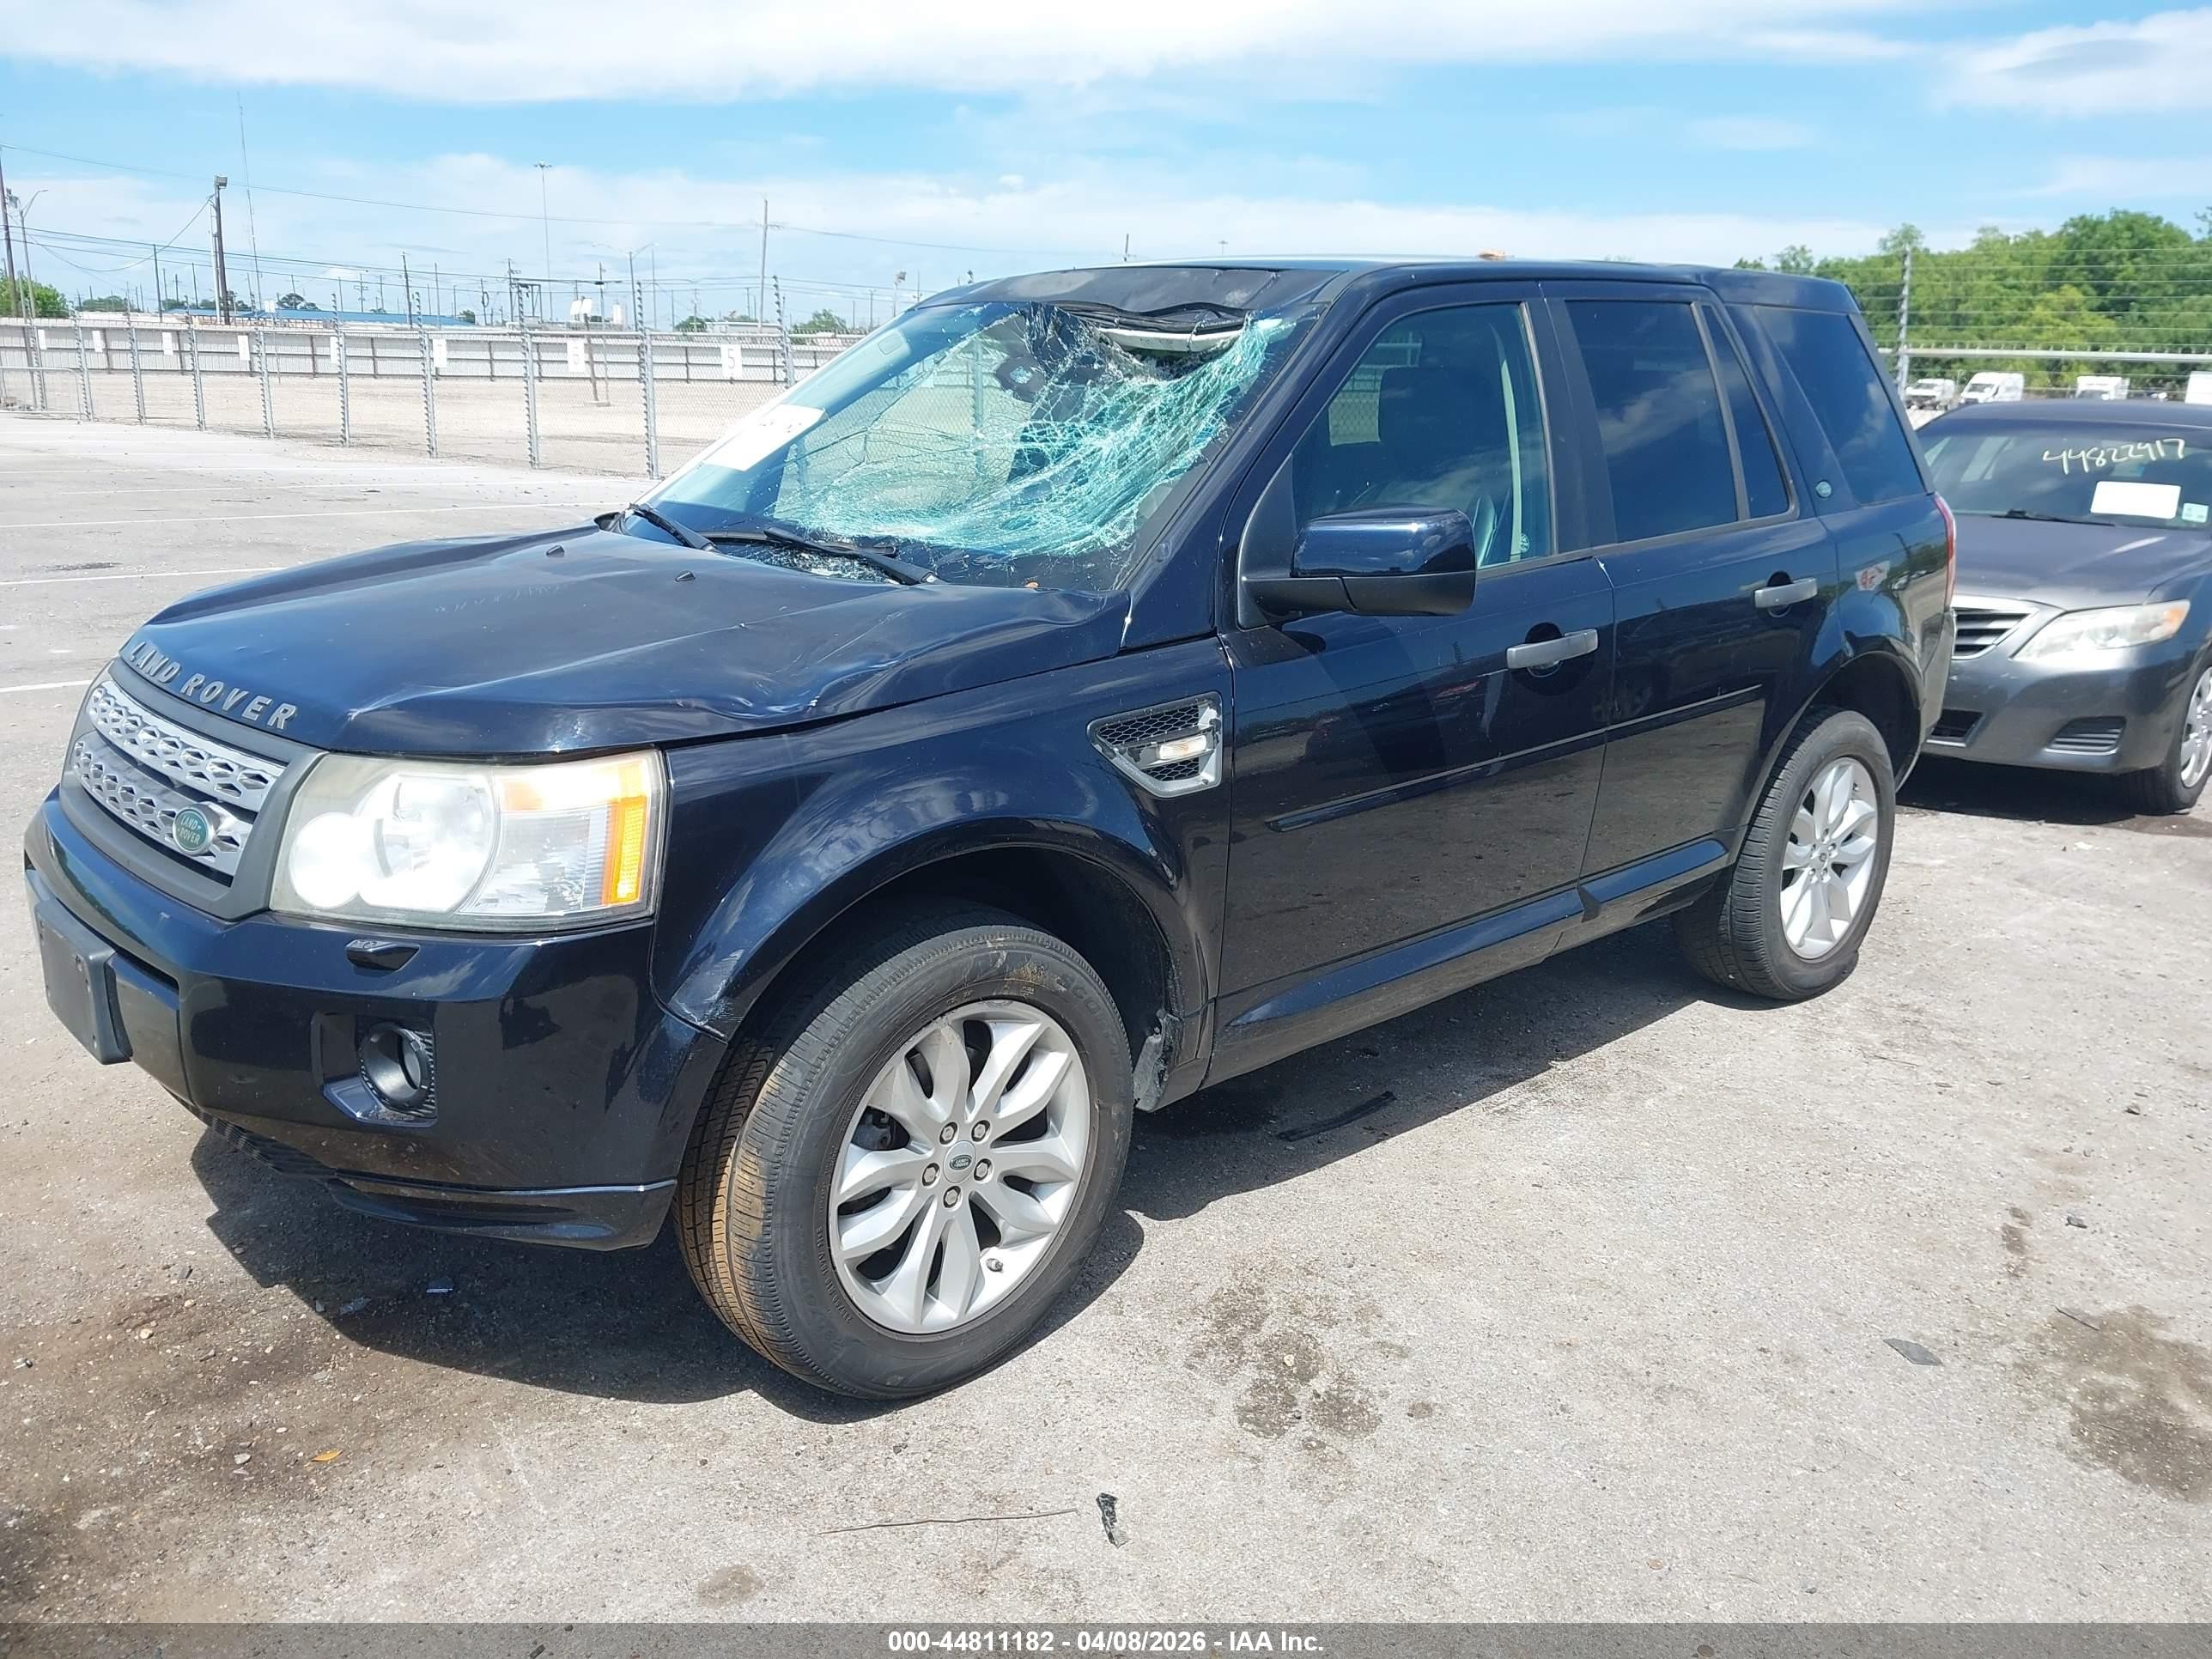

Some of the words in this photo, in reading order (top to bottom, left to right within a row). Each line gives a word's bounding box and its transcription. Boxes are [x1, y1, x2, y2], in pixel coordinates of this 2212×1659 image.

[728, 348, 736, 369] 5
[131, 641, 181, 684] LAND
[180, 672, 298, 730] ROVER
[180, 815, 198, 830] LAND
[179, 827, 201, 845] ROVER
